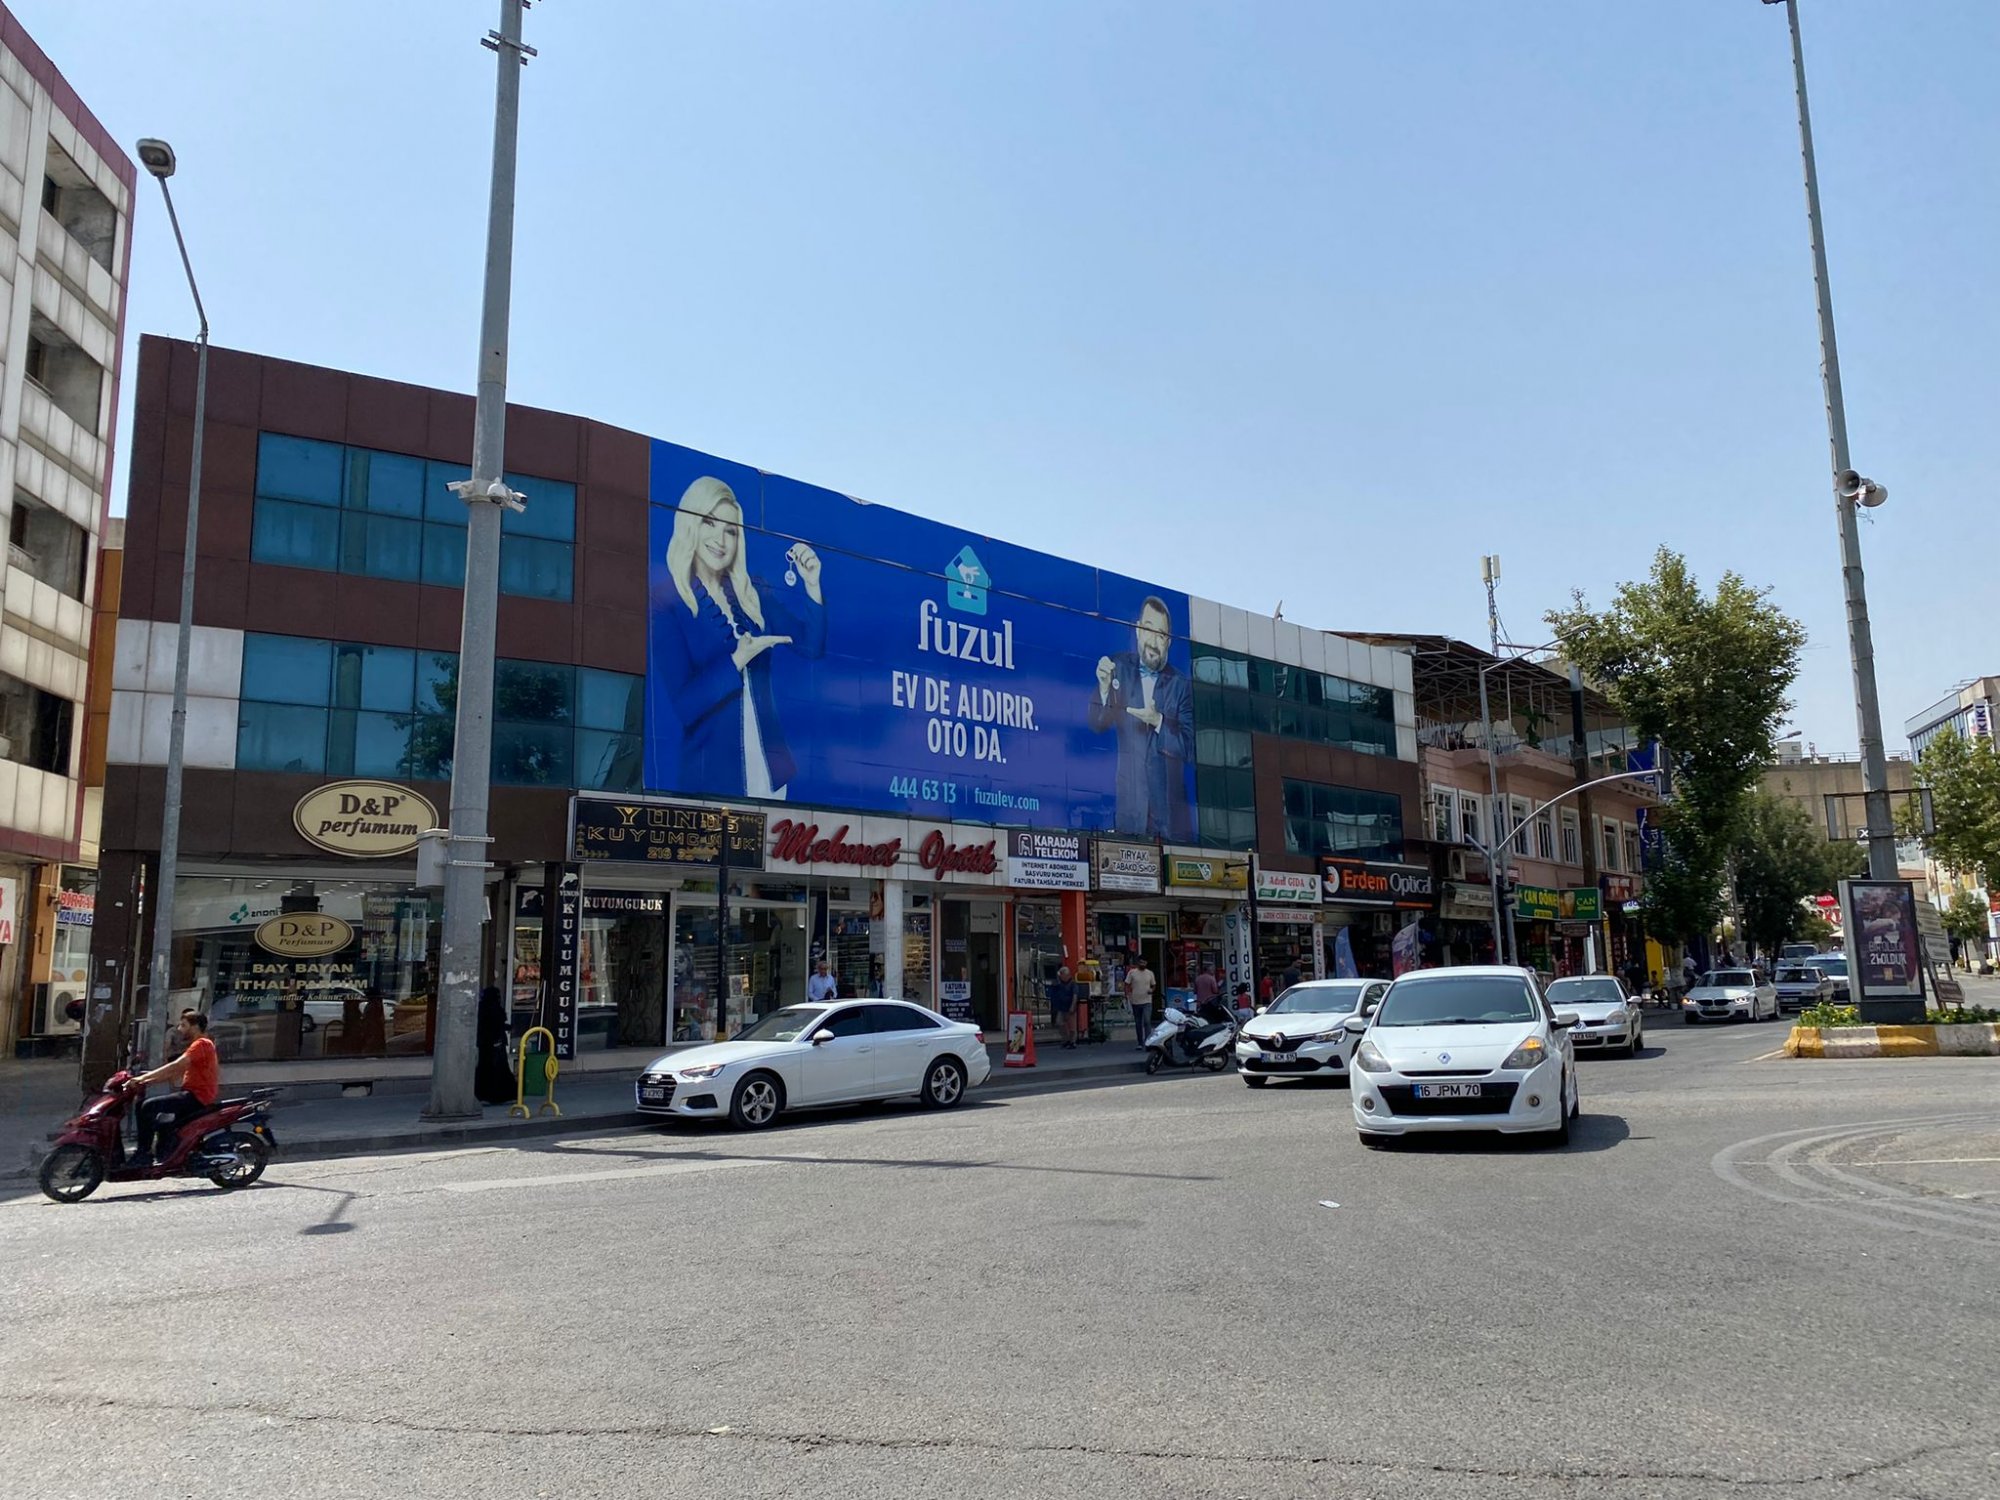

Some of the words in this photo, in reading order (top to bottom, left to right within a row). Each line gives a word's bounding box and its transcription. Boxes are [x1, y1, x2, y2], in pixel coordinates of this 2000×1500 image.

[918, 599, 1015, 670] fuzul
[892, 670, 919, 709] EV
[925, 677, 951, 716] DE
[957, 684, 1039, 731] ALDIRIR.
[927, 718, 968, 758] OTO
[974, 726, 1007, 764] DA.
[889, 775, 918, 799] 444
[921, 779, 940, 801] 63
[942, 783, 956, 803] 13
[974, 787, 1040, 811] fuzulev.com
[315, 818, 418, 837] perfumum
[1034, 834, 1079, 849] KARADAĞ
[1035, 847, 1079, 860] TELEKOM
[1342, 869, 1389, 893] Erdem
[1390, 873, 1432, 896] Optical
[1575, 897, 1596, 906] CAN
[279, 922, 335, 937] D&P
[252, 964, 289, 973] BAY
[295, 964, 353, 973] BAYAN
[1420, 1086, 1430, 1097] 16
[1437, 1085, 1460, 1096] JPM
[1465, 1085, 1479, 1096] 70
